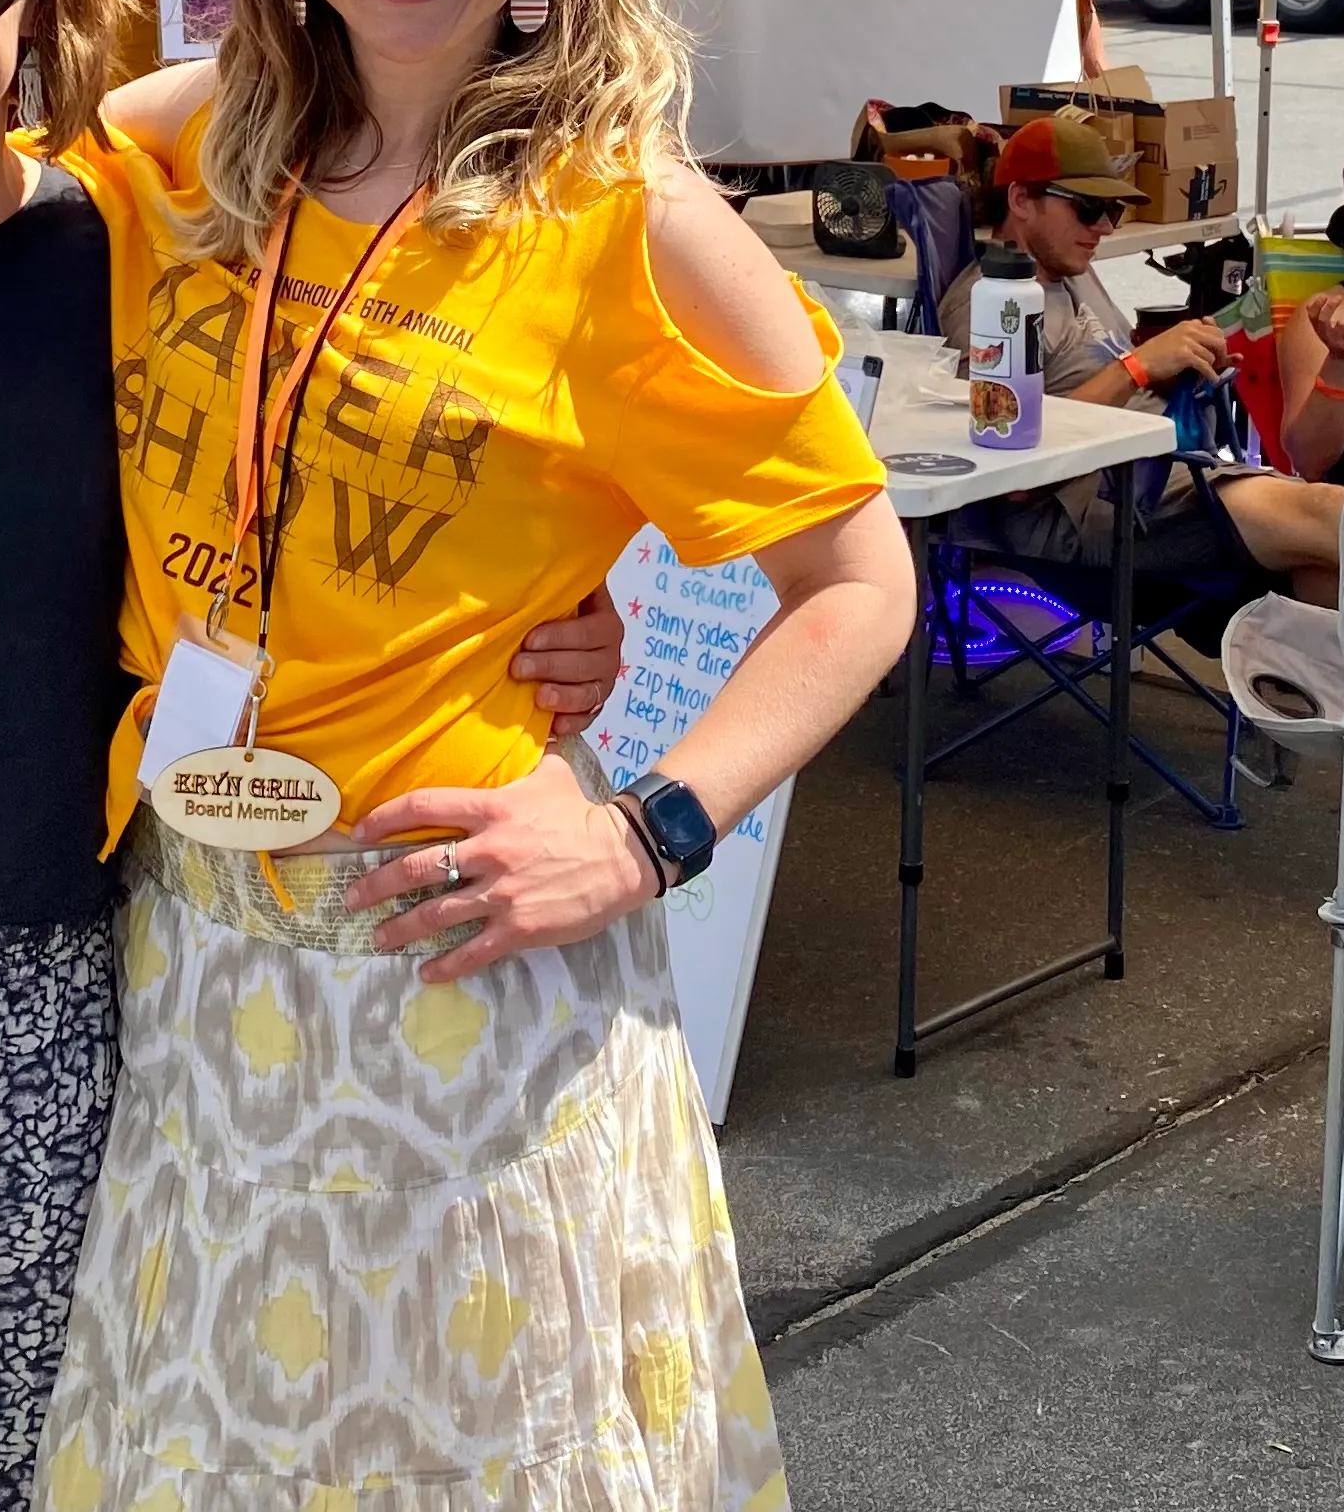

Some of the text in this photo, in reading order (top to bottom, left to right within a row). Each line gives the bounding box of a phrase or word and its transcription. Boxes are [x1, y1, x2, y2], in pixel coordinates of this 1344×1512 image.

[246, 266, 360, 316] RNDHOUE
[360, 298, 399, 325] 6TH
[398, 309, 474, 356] ANNUAL
[162, 532, 258, 609] 2022
[679, 580, 755, 619] square!
[696, 648, 732, 680] dire
[624, 689, 667, 733] keep
[665, 673, 712, 712] throu
[248, 777, 323, 802] GRILL
[184, 799, 309, 823] Board Member
